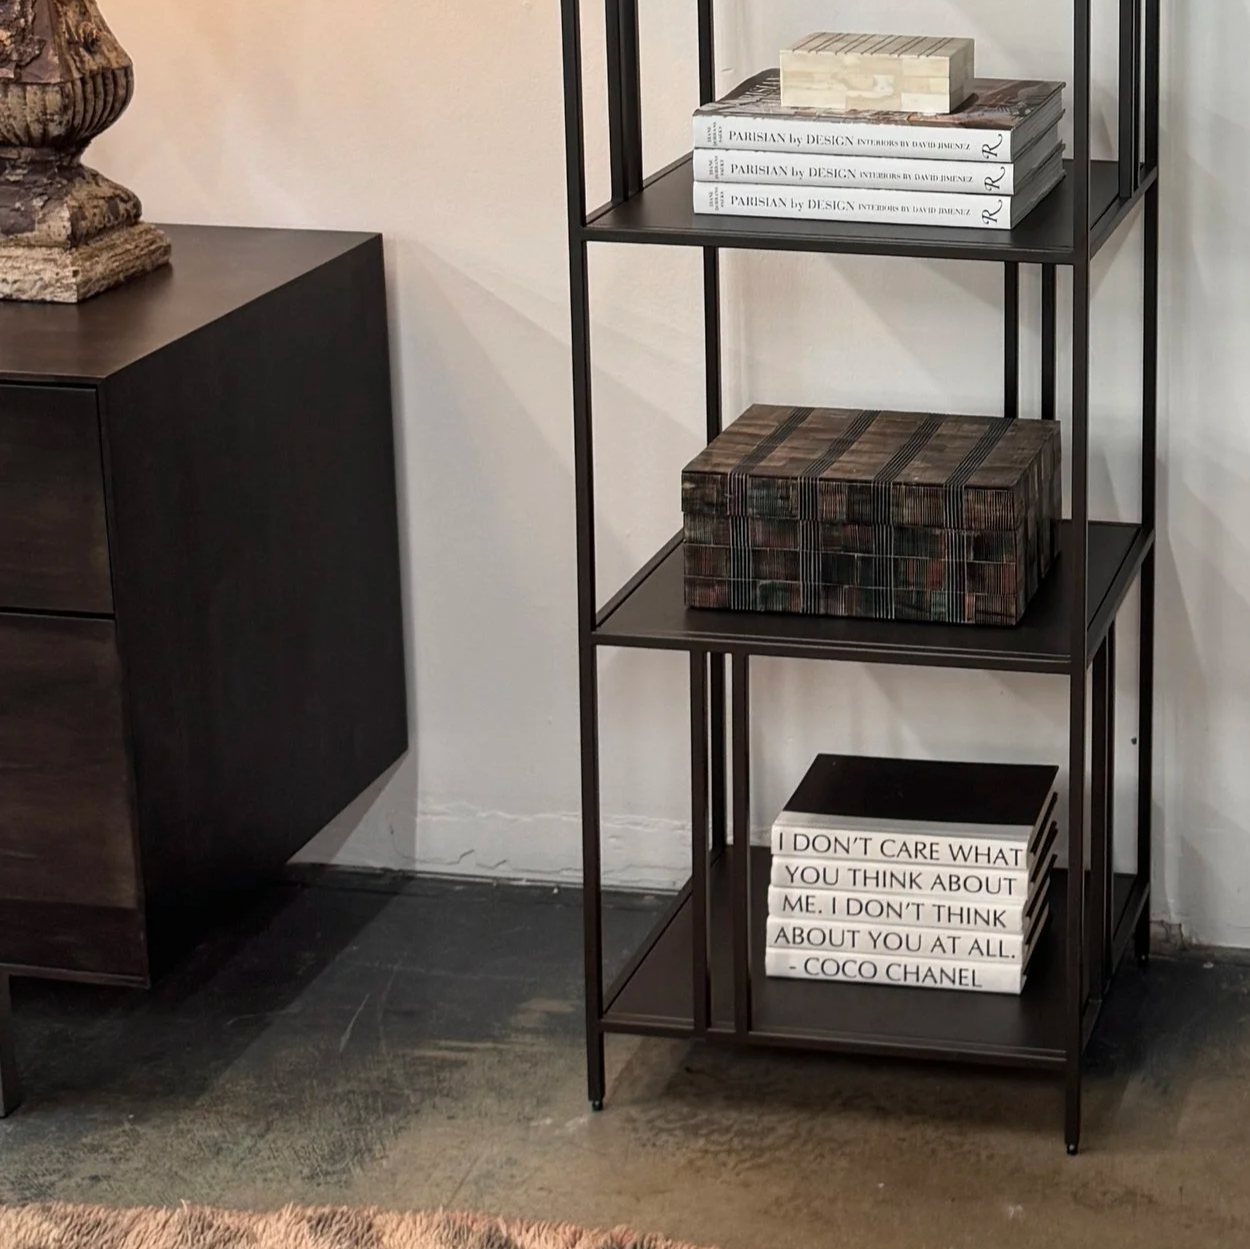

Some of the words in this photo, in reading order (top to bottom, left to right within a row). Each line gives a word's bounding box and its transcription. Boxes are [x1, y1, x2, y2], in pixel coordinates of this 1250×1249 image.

[729, 130, 785, 143] PARISIAN
[790, 133, 802, 147] by
[806, 134, 854, 146] DESIGN
[857, 138, 898, 147] INTERIORS
[900, 139, 910, 147] BY
[912, 141, 936, 149] DAVID
[938, 142, 971, 150] JIMENEZ
[731, 163, 787, 176] PARISIAN
[791, 166, 804, 180] by
[809, 167, 856, 179] DESIGN
[860, 171, 900, 180] INTERIORS
[903, 172, 912, 181] BY
[914, 174, 938, 182] DAVID
[941, 175, 973, 183] JIMENEZ
[731, 195, 787, 208] PARISIAN
[790, 198, 804, 211] by
[808, 199, 854, 210] DESIGN
[858, 203, 899, 212] INTERIORS
[901, 204, 910, 212] BY
[912, 206, 936, 214] DAVID
[938, 207, 971, 215] JIMENEZ
[779, 832, 783, 850] I
[793, 833, 872, 856] DON'T
[880, 838, 940, 861] CARE
[948, 843, 1023, 866] WHAT
[785, 865, 839, 886] YOU
[848, 868, 923, 890] THINK
[930, 873, 1017, 895] ABOUT
[782, 894, 822, 914] ME.
[832, 896, 836, 914] I
[846, 897, 925, 921] DON'T
[932, 903, 1006, 928] THINK
[774, 926, 860, 948] ABOUT
[868, 931, 921, 952] YOU
[930, 935, 961, 954] AT
[968, 938, 1015, 958] ALL.
[804, 956, 877, 979] COCO
[886, 962, 982, 988] CHANEL
